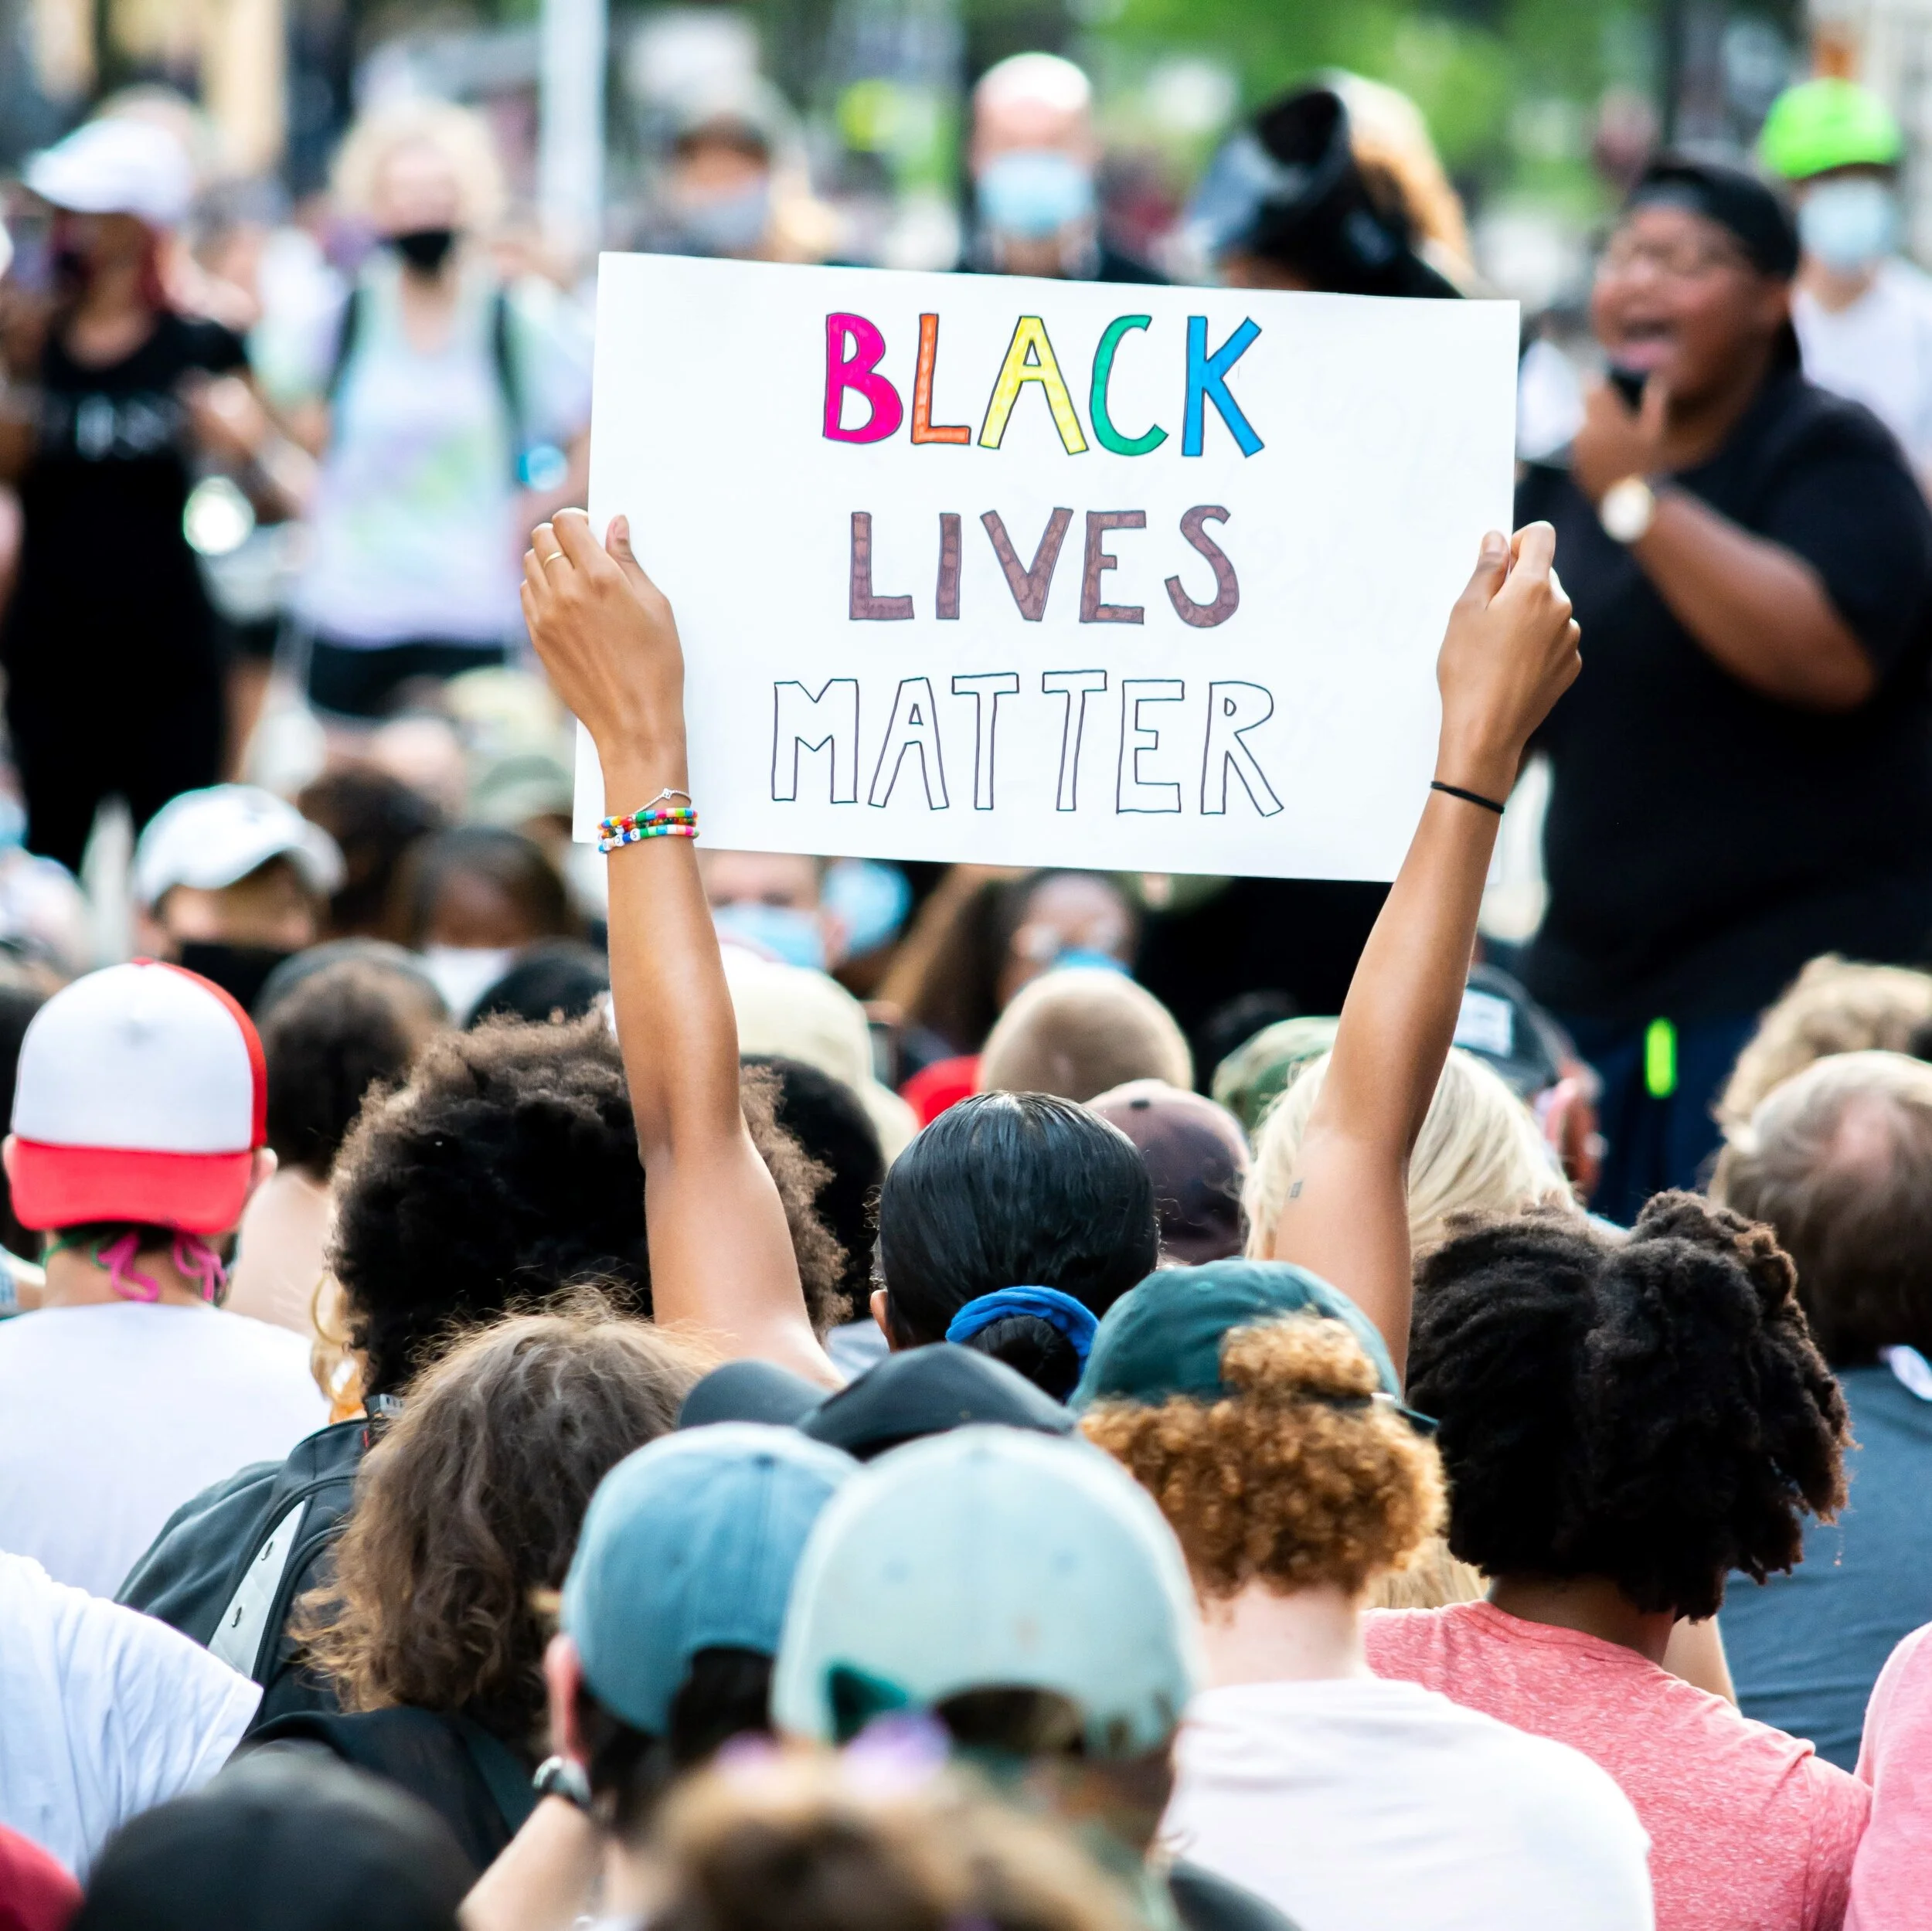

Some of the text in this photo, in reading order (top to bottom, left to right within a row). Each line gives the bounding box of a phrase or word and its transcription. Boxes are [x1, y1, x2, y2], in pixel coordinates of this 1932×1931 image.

[822, 312, 1265, 458] BLACK
[849, 505, 1240, 628] LIVES
[771, 670, 1284, 817] MATTER
